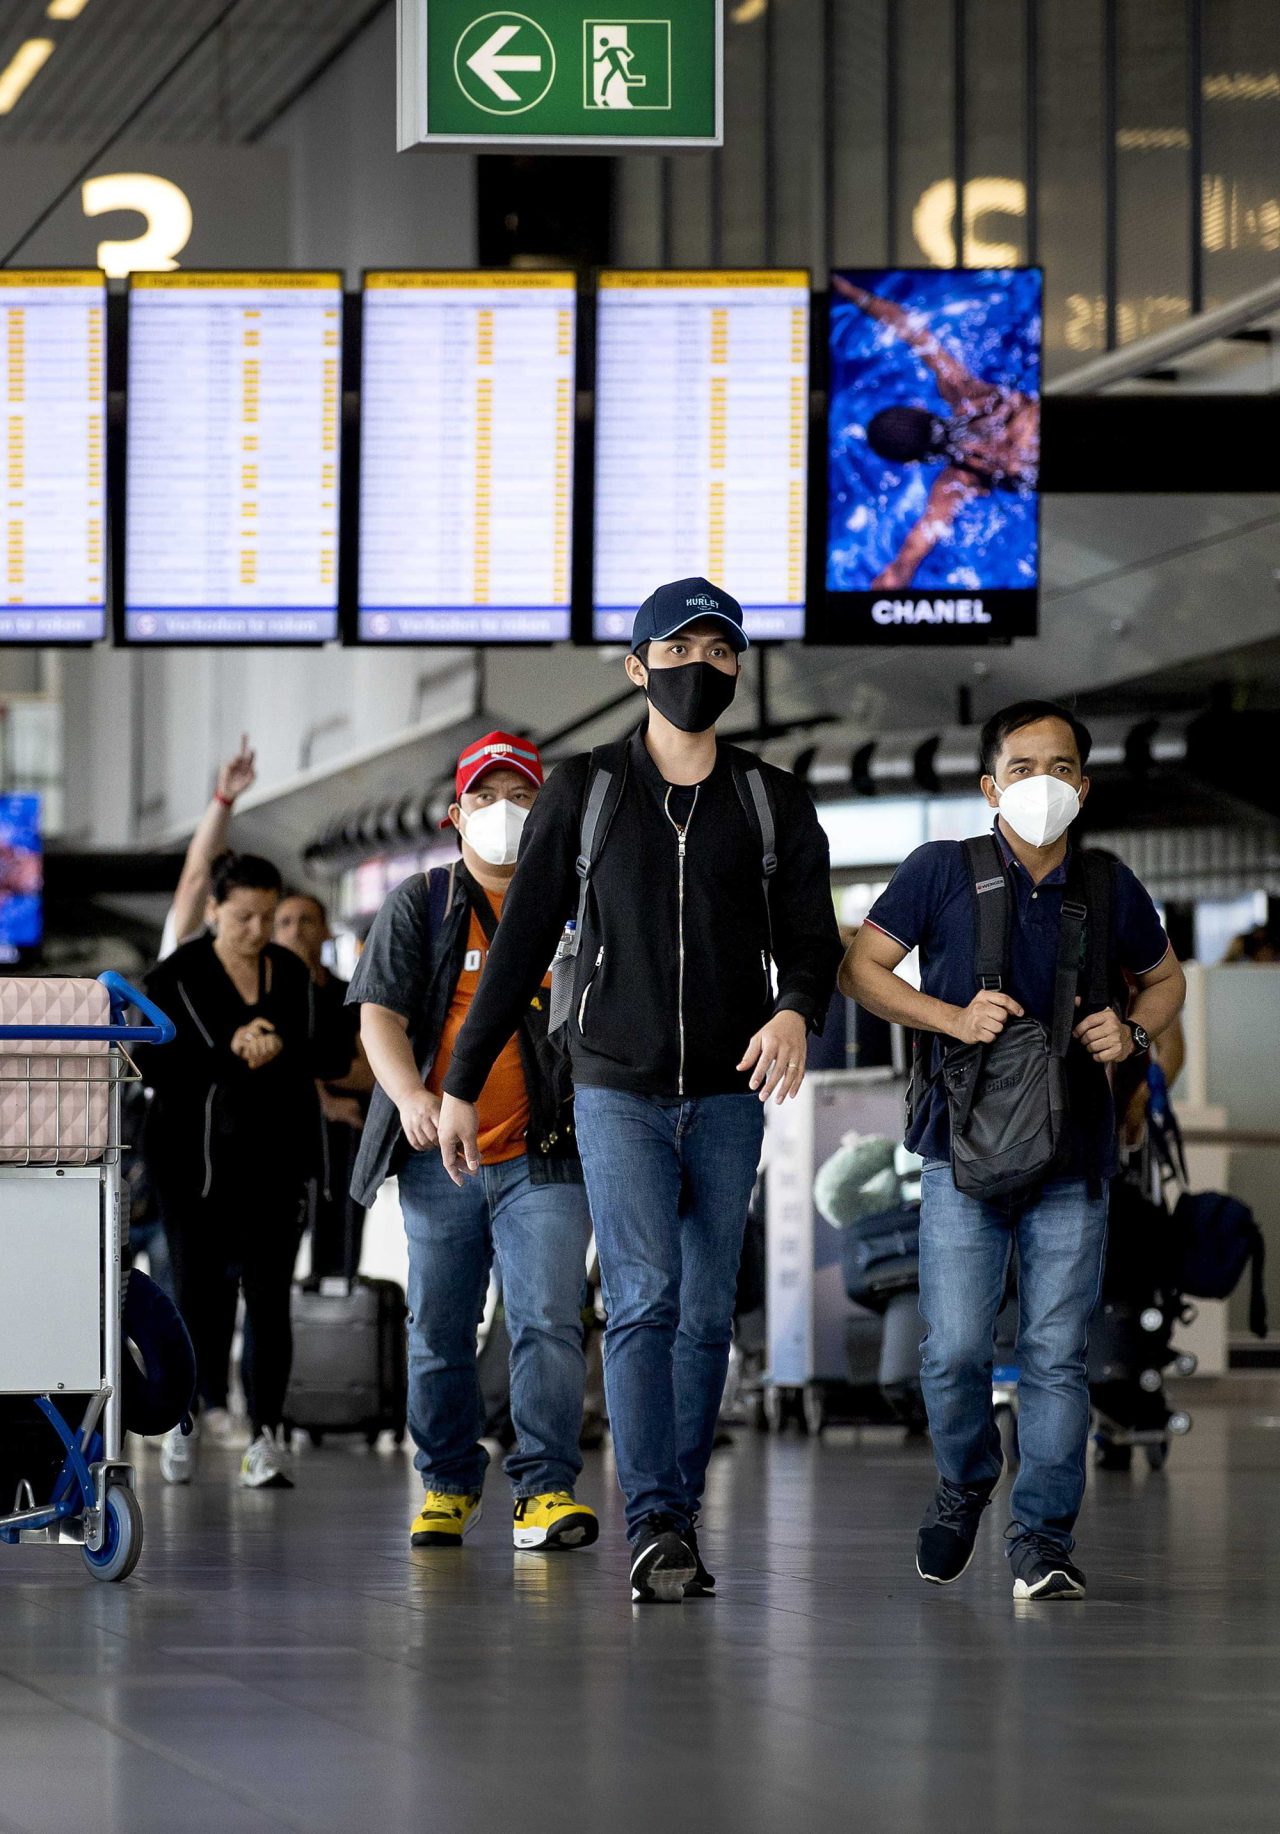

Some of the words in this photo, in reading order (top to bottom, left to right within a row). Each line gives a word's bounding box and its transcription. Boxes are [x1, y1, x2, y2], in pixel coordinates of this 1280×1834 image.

[686, 598, 719, 609] HURLEY
[872, 599, 992, 625] CHANEL
[484, 743, 513, 755] PUMA
